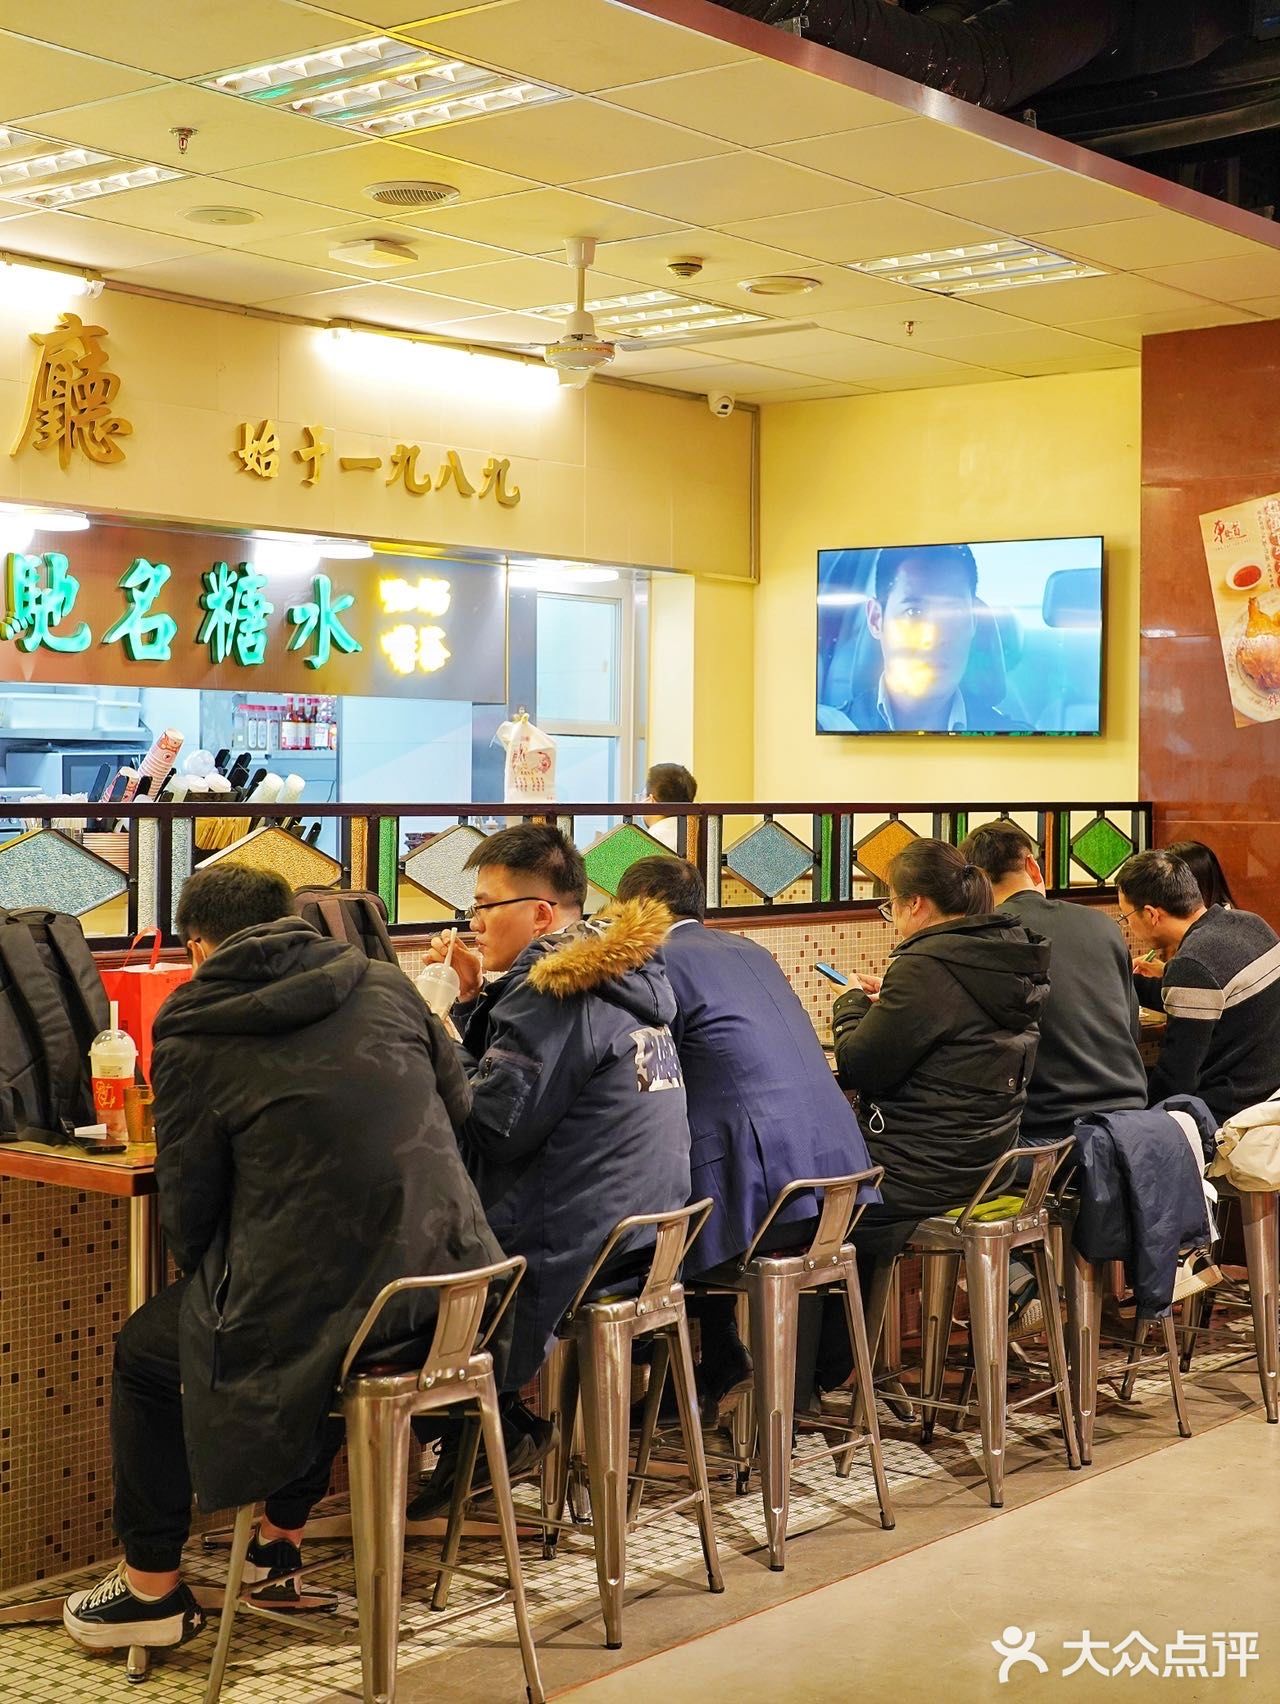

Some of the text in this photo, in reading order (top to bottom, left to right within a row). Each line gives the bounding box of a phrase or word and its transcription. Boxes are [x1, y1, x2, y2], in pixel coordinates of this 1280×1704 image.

[10, 312, 133, 470] 廳
[0, 552, 363, 669] 馳名糖水
